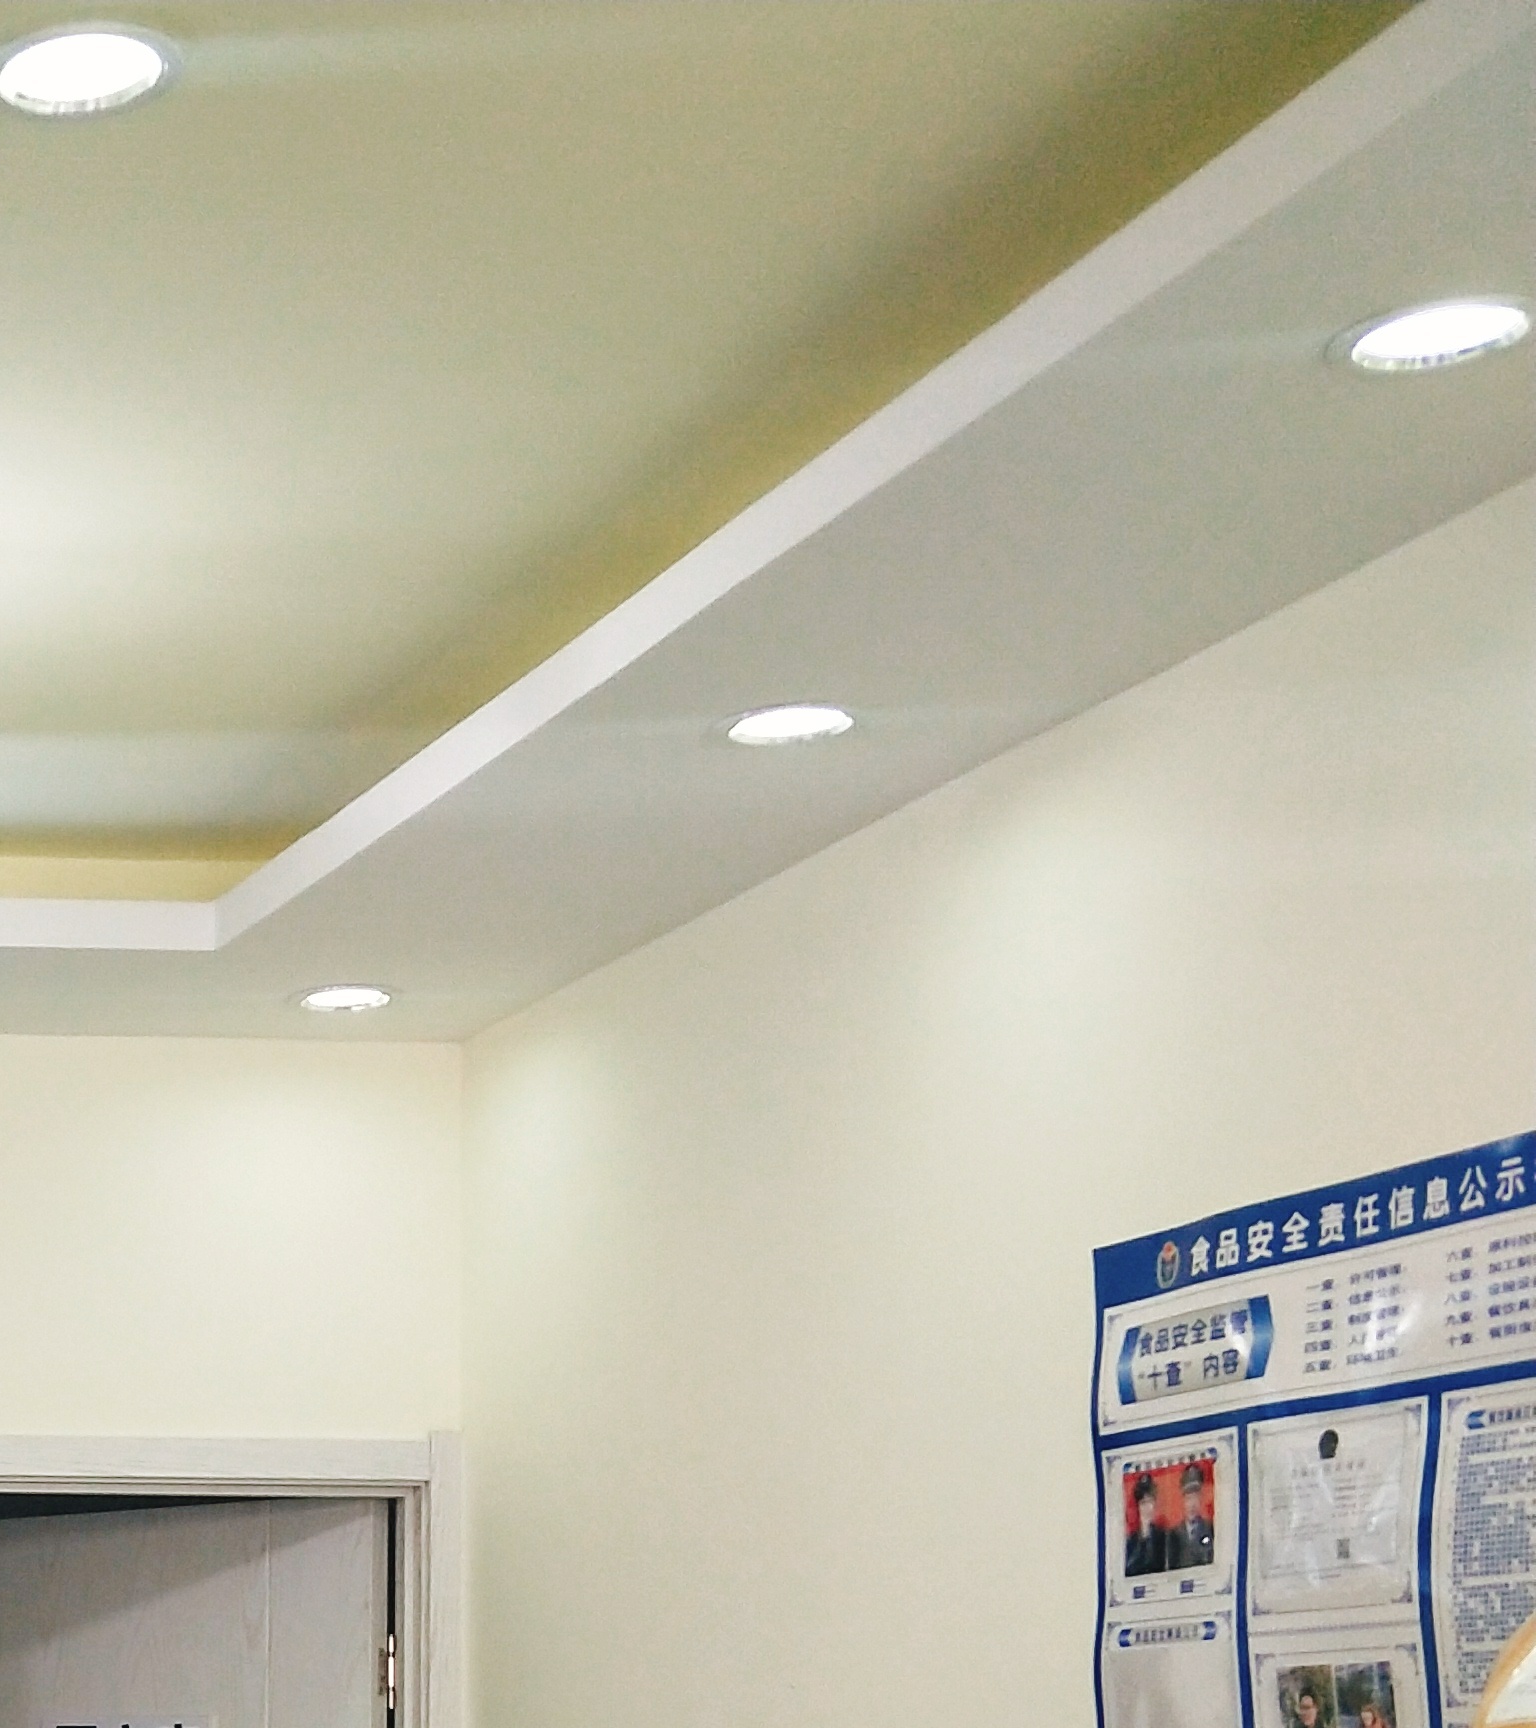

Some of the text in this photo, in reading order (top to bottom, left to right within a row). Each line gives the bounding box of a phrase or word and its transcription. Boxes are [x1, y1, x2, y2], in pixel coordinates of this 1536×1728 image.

[1189, 1155, 1536, 1277] 食品安全责任信息公示
